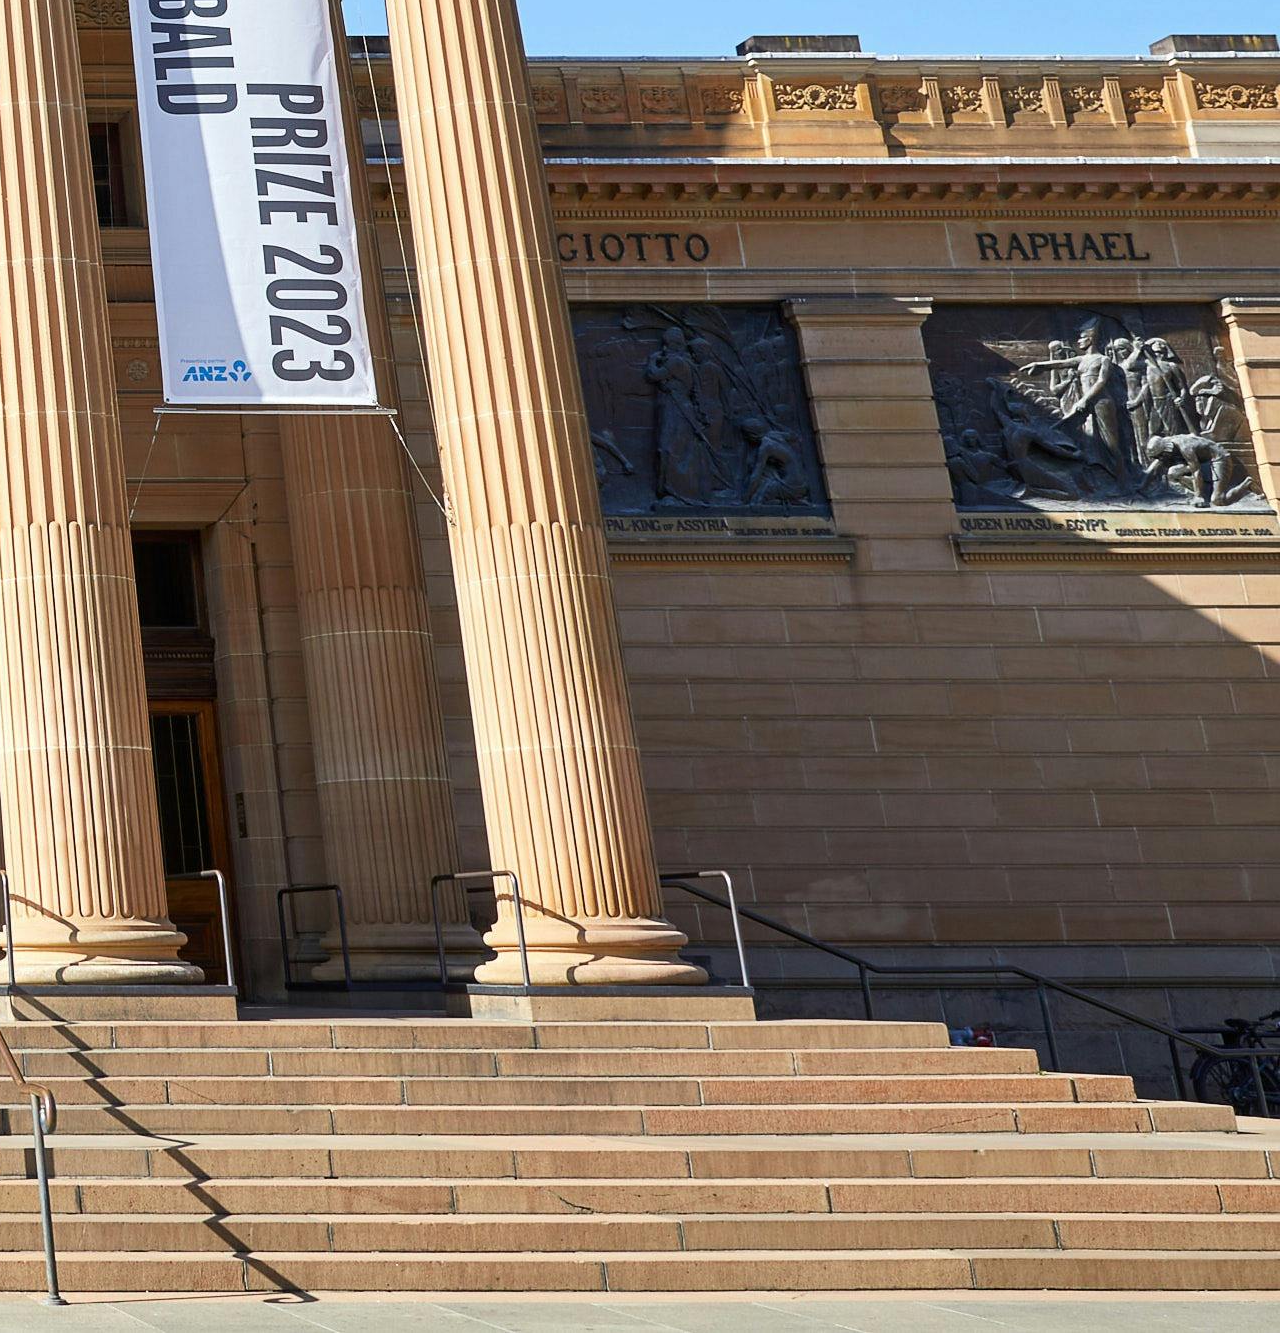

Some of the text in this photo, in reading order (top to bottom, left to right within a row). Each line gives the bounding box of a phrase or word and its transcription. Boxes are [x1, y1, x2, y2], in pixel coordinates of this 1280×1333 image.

[246, 82, 355, 382] PRIZE 2023
[975, 232, 1151, 261] RAPHAEL
[557, 233, 710, 262] GIOTTO
[182, 366, 228, 382] ANZ
[960, 518, 1003, 531] QUEEN
[1005, 518, 1052, 530] HATASU
